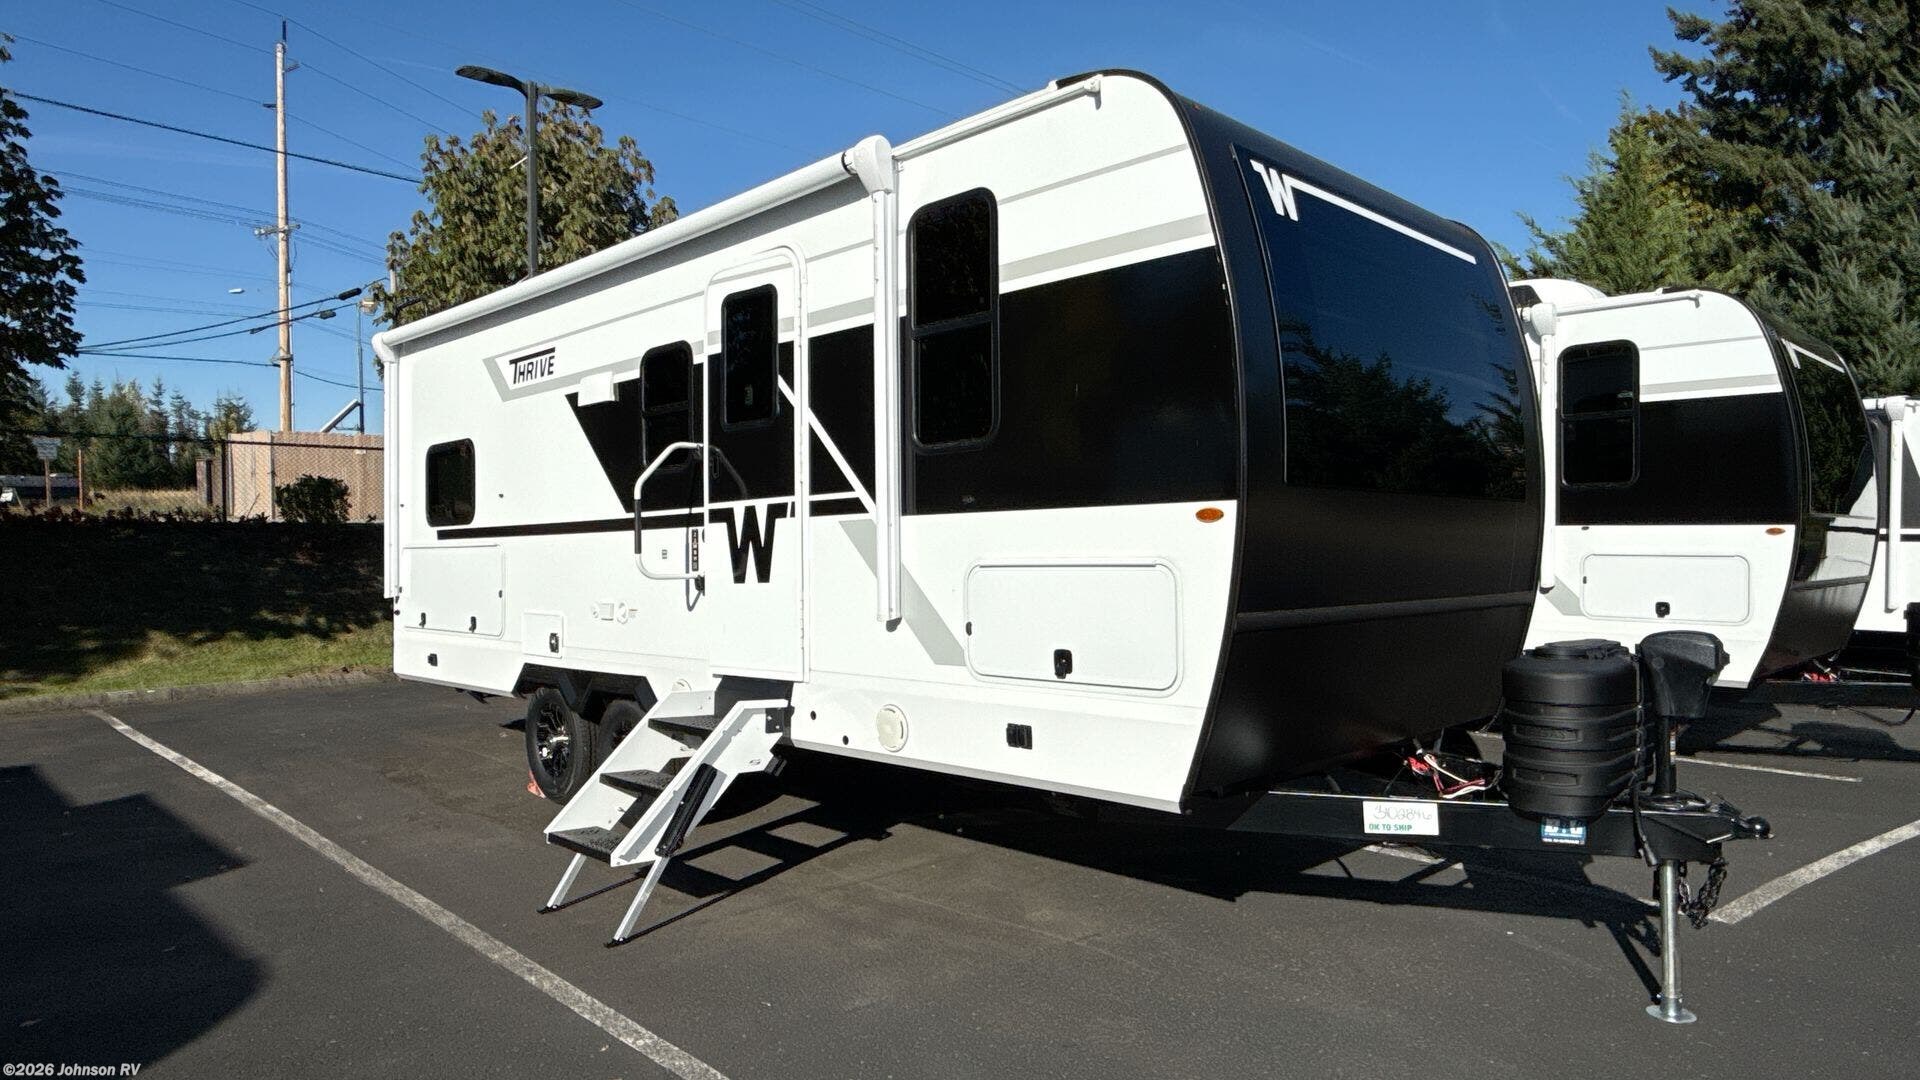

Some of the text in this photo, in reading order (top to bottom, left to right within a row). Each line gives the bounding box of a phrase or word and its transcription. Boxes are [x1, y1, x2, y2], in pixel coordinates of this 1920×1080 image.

[509, 346, 555, 385] THRIVE
[1369, 823, 1380, 831] OK
[1393, 824, 1413, 832] SHIP
